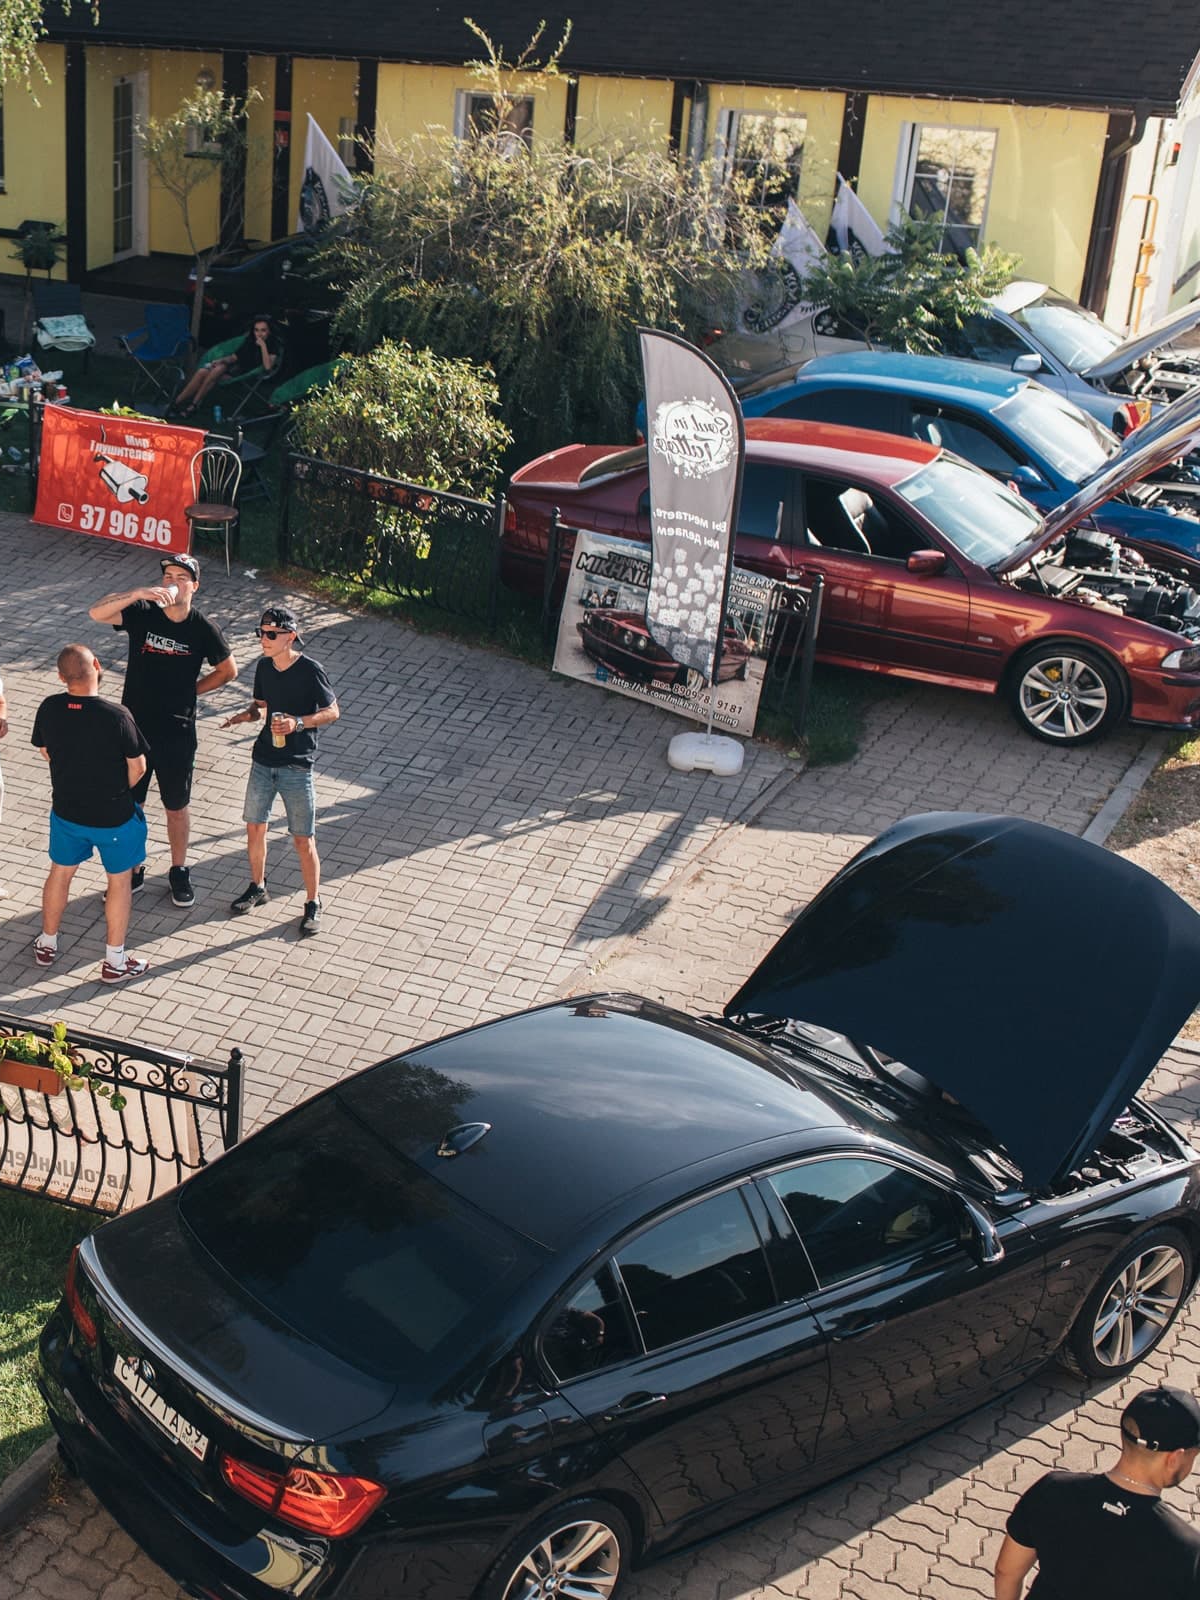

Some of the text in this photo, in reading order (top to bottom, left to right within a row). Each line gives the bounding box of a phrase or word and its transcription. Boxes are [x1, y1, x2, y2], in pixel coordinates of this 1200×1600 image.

[125, 434, 150, 449] Мир
[79, 503, 172, 545] 37 96 96
[577, 552, 648, 588] MIKHAIL
[608, 552, 649, 572] TUNING
[729, 584, 767, 600] пчасти
[749, 576, 776, 589] BMW
[146, 631, 176, 652] HKS
[673, 683, 743, 715] 8909789181
